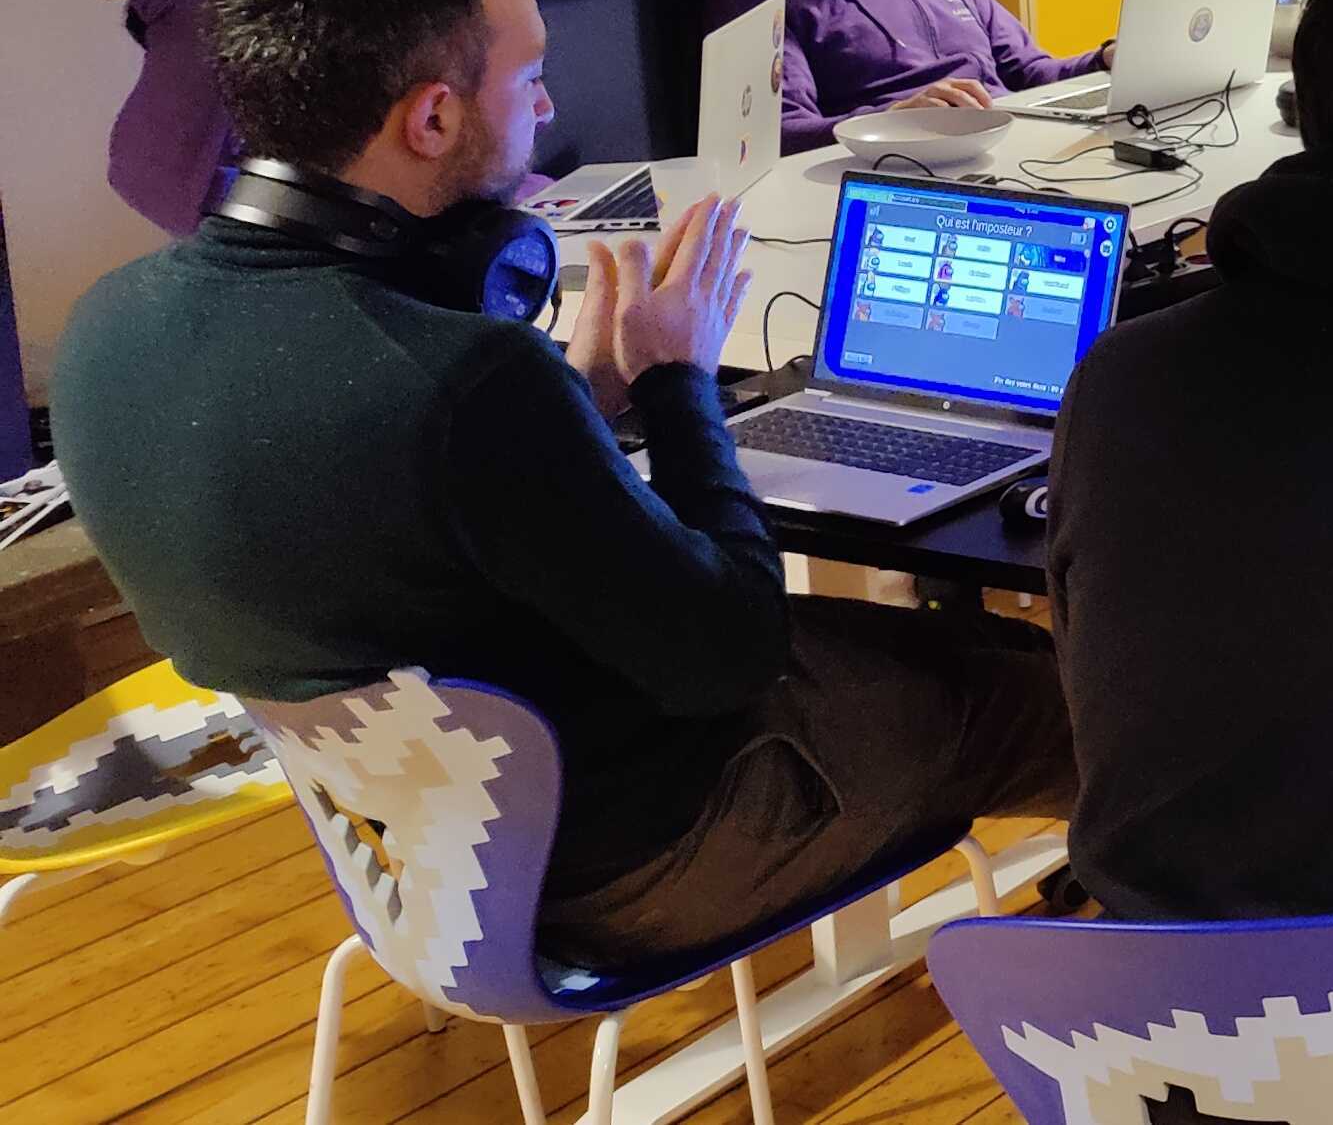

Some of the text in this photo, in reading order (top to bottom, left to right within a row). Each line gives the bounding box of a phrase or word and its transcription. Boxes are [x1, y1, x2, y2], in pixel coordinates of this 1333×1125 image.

[936, 215, 1033, 237] Qui est l'imposteur ?
